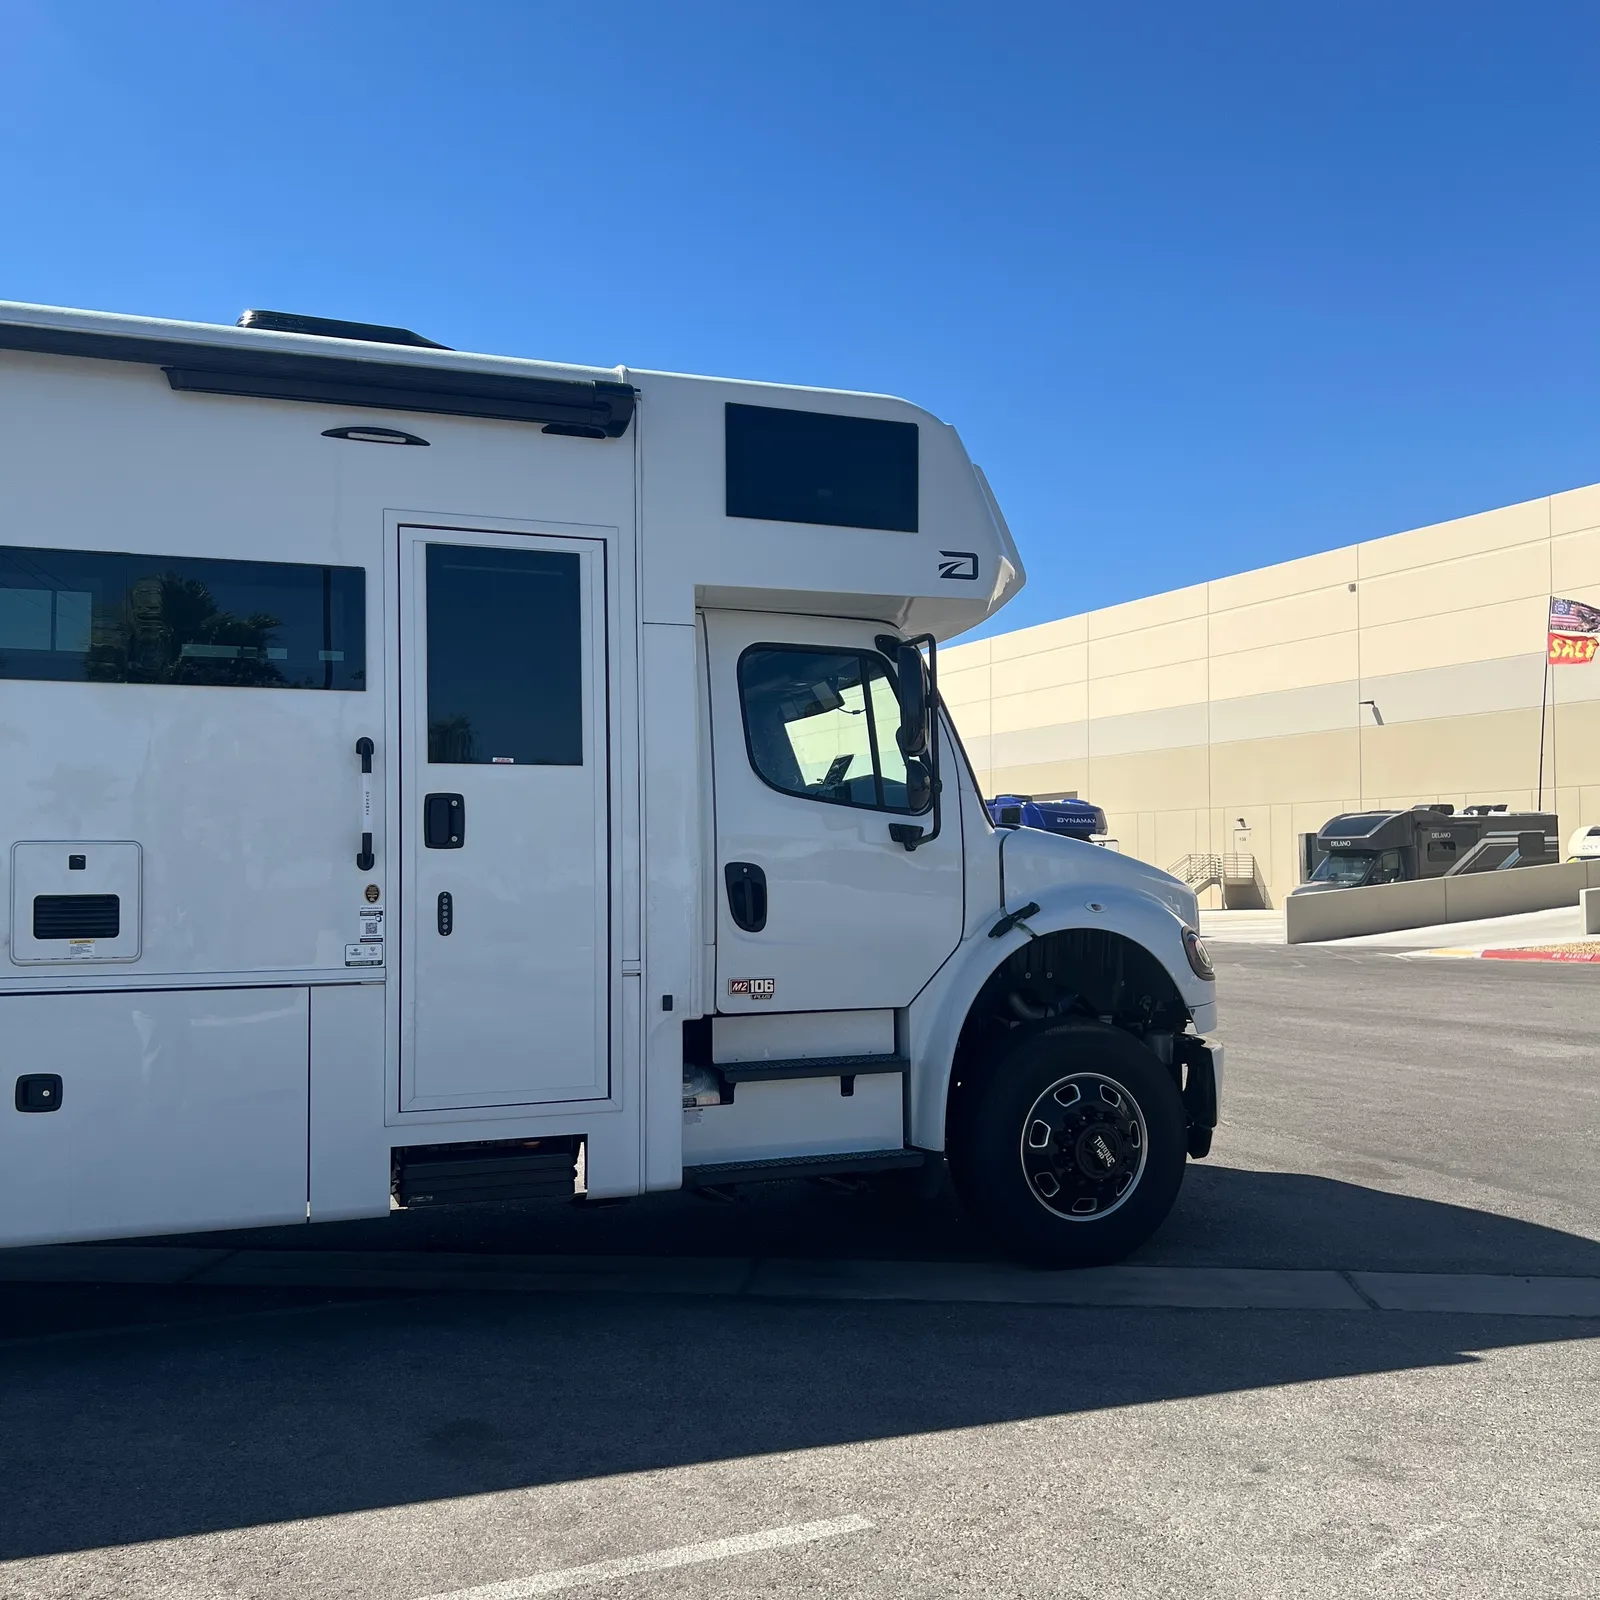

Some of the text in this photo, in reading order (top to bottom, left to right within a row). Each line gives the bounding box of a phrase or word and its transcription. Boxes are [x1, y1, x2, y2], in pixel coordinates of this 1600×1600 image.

[732, 979, 774, 993] M2 106
[1093, 1135, 1116, 1167] TORQUE
